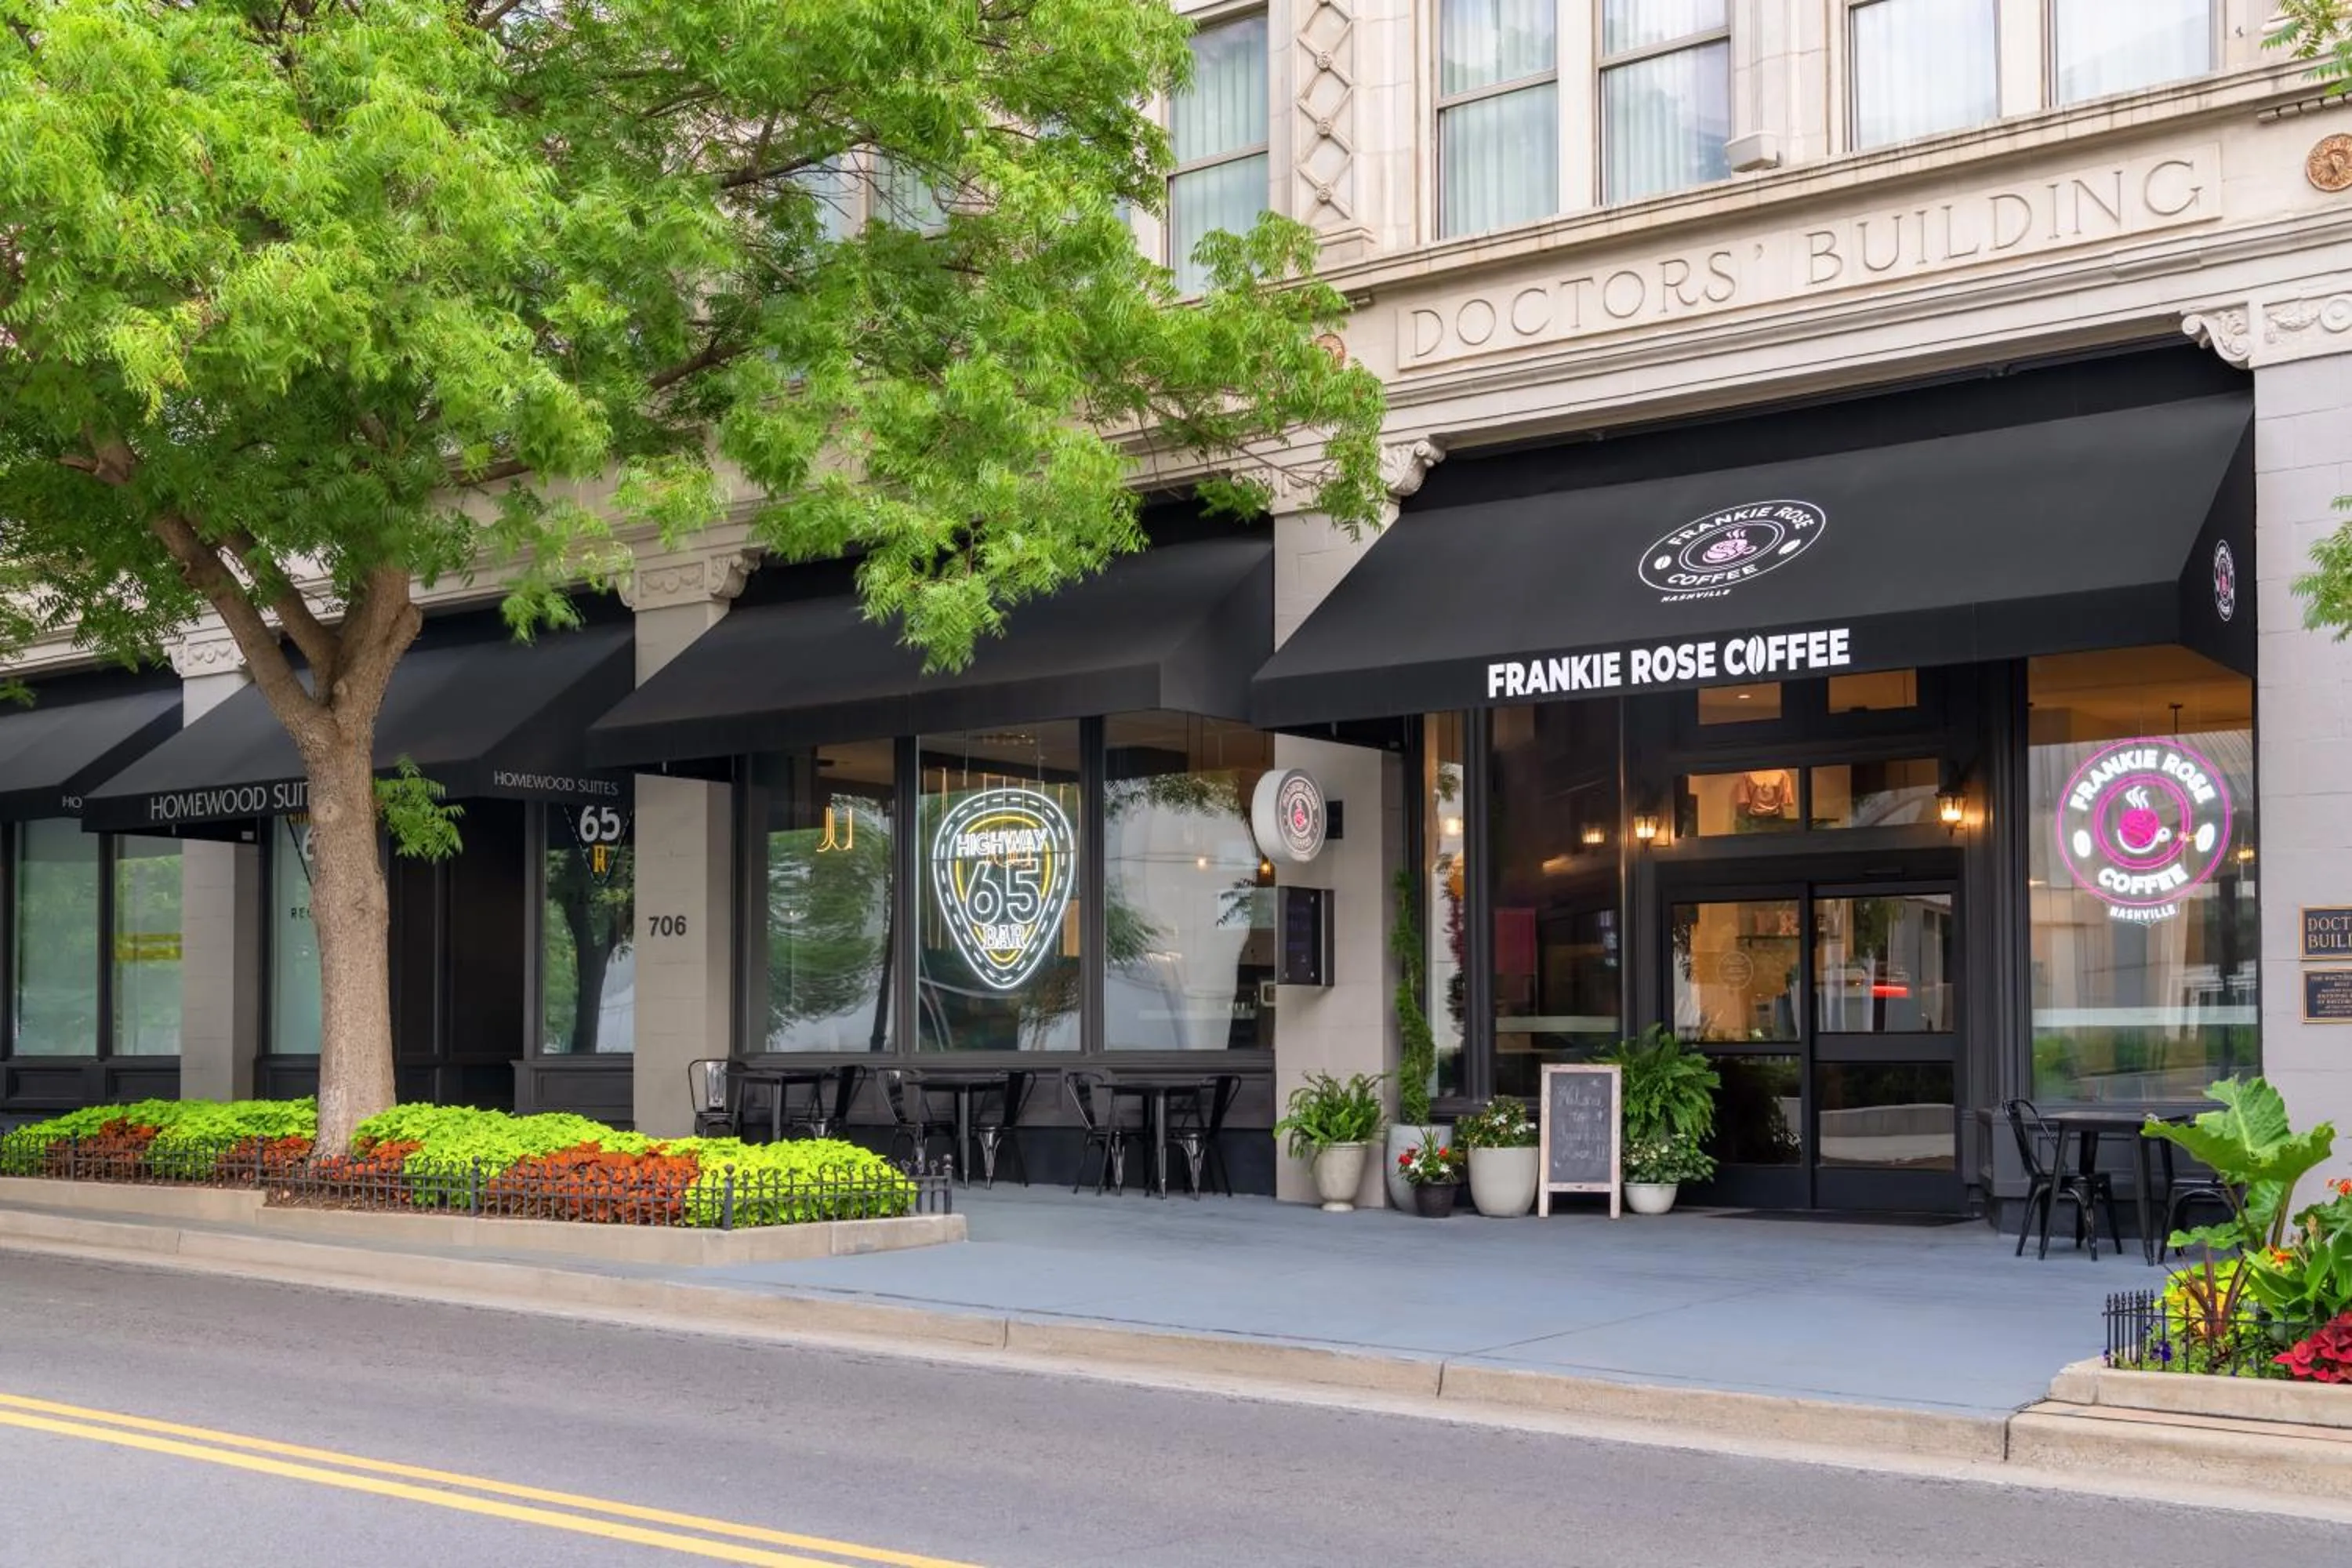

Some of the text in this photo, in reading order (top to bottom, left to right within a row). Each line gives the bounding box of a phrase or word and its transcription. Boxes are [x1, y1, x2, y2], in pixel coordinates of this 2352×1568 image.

[1806, 160, 2201, 285] BUILDING
[1668, 506, 1815, 546] FRANKIE ROSE
[1667, 564, 1759, 586] COFFEE
[1661, 589, 1731, 603] NASHVILLE
[1488, 628, 1850, 699] FRANKIE ROSE COFFEE
[494, 770, 619, 797] HOMEWOOD SUITES
[2070, 750, 2216, 811] FRANKIE ROSE
[150, 782, 310, 819] HOMEWOOD SUIT
[579, 805, 621, 842] 65
[956, 828, 1048, 856] HIGHWAY
[965, 858, 1041, 924] 65
[2098, 863, 2189, 895] COFFEE
[648, 915, 687, 936] 706
[2110, 904, 2176, 920] NASHVILLE
[984, 924, 1025, 950] BAR
[2307, 933, 2352, 948] BUIL
